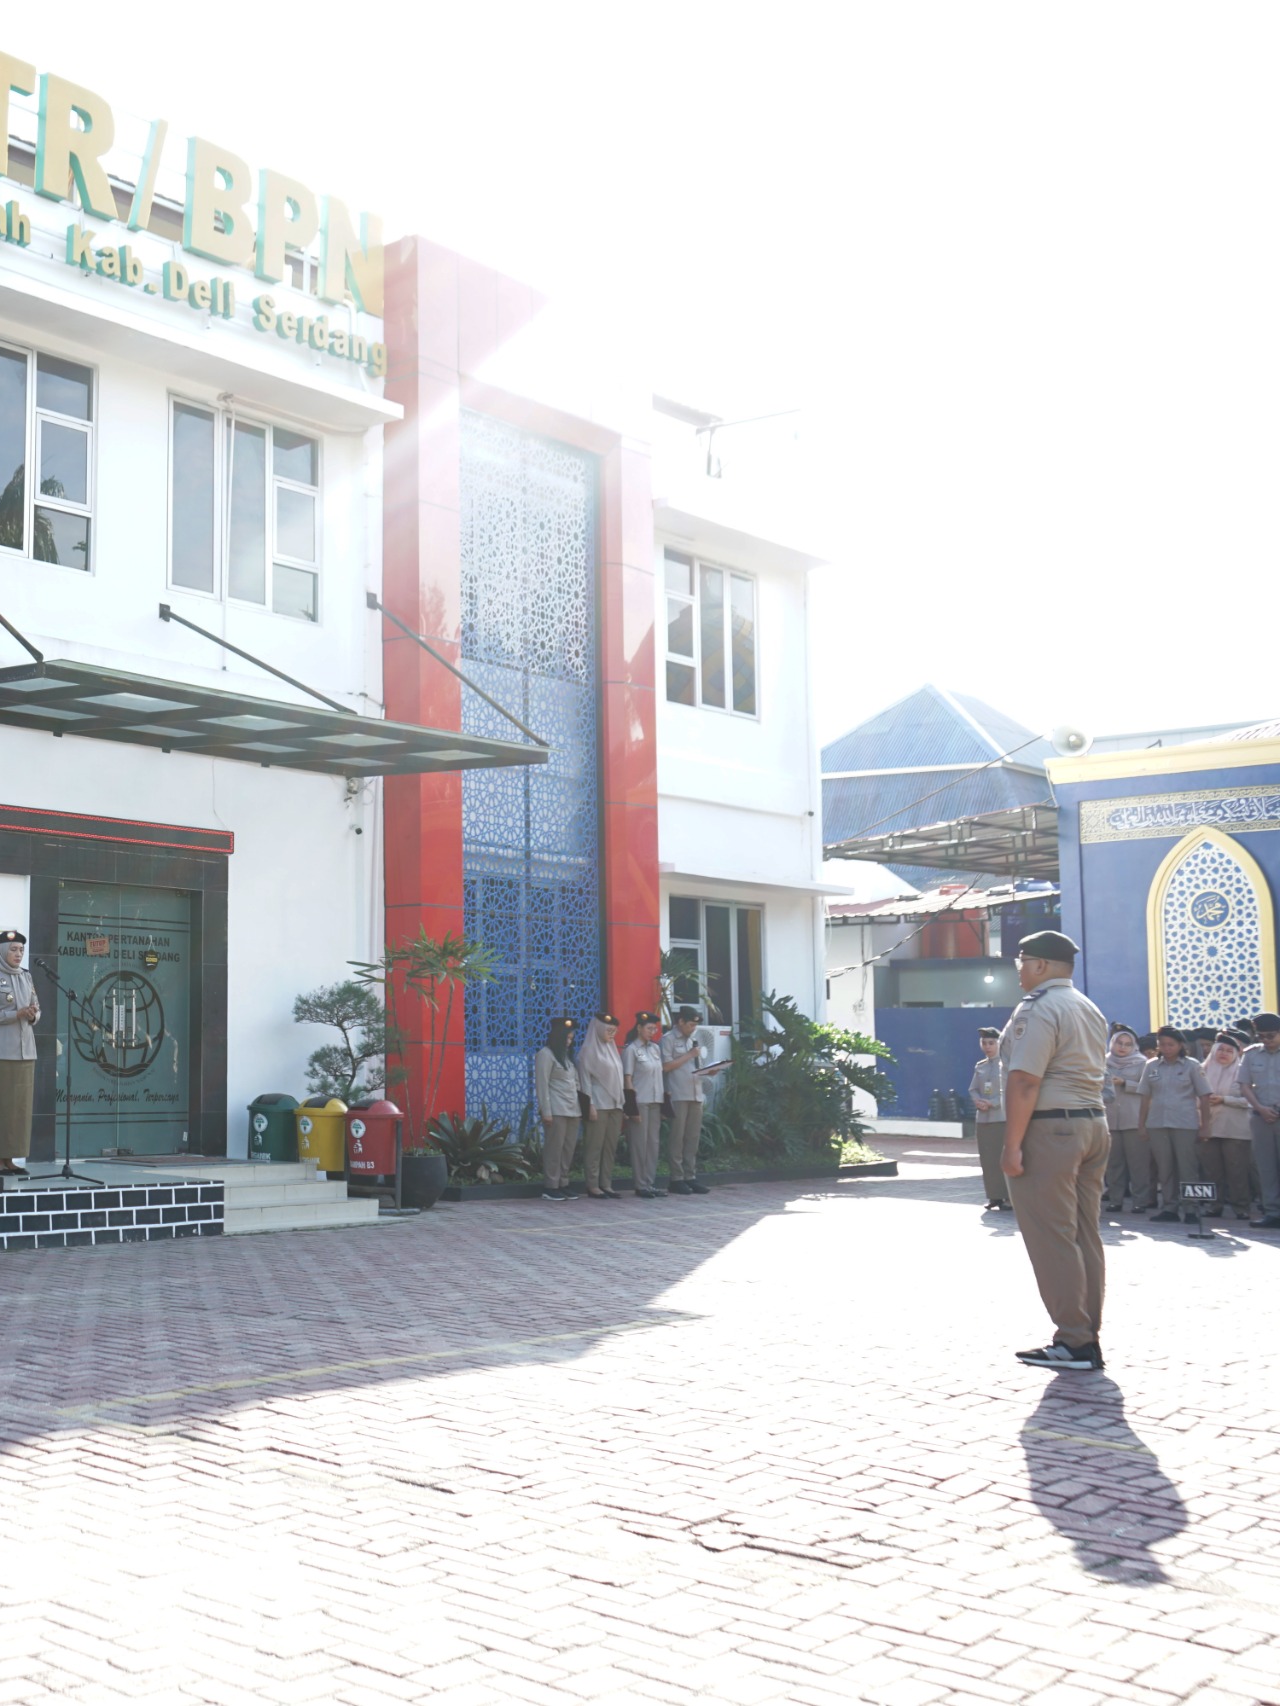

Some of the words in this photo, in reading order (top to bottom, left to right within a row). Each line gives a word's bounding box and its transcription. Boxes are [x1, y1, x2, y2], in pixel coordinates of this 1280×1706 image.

[252, 294, 388, 377] Serdang
[113, 948, 136, 960] DELI
[1184, 1184, 1213, 1198] ASN
